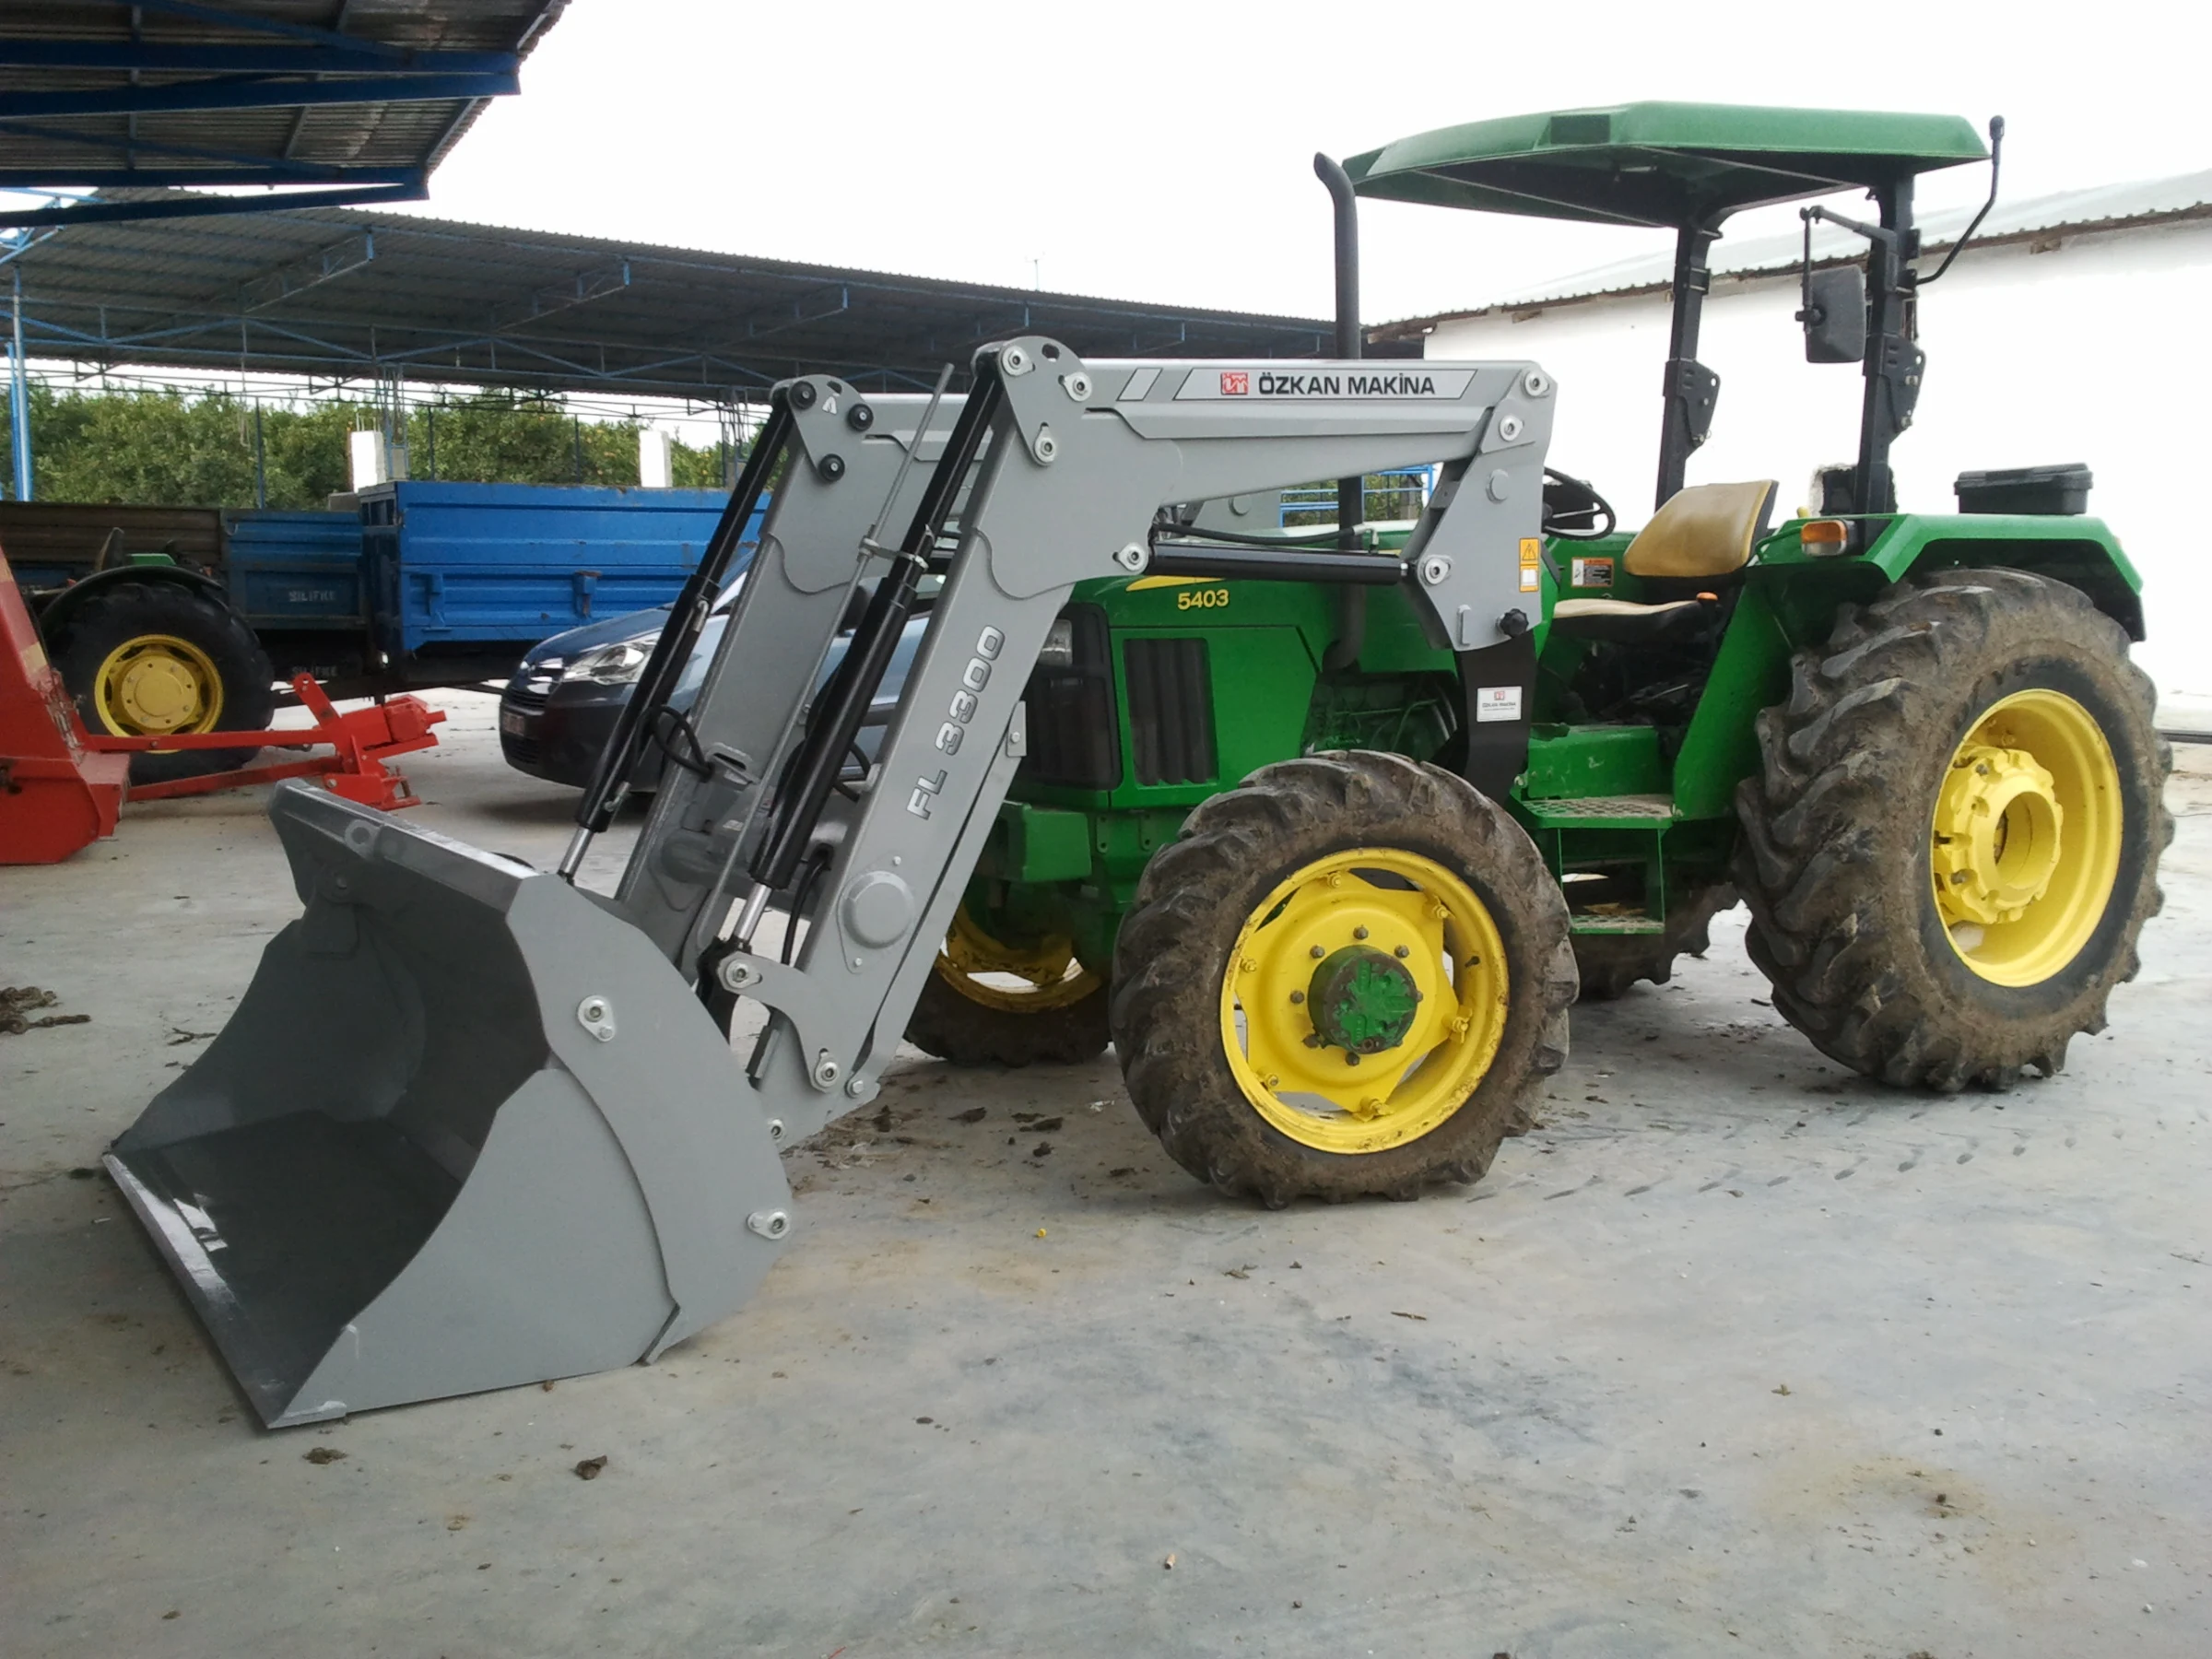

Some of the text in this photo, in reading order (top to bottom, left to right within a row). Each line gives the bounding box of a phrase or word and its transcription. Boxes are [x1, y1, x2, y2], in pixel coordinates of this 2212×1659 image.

[1258, 371, 1436, 395] ÖZKAN MAKİNA
[1177, 589, 1230, 610] 5403
[906, 624, 1006, 820] FL 3300
